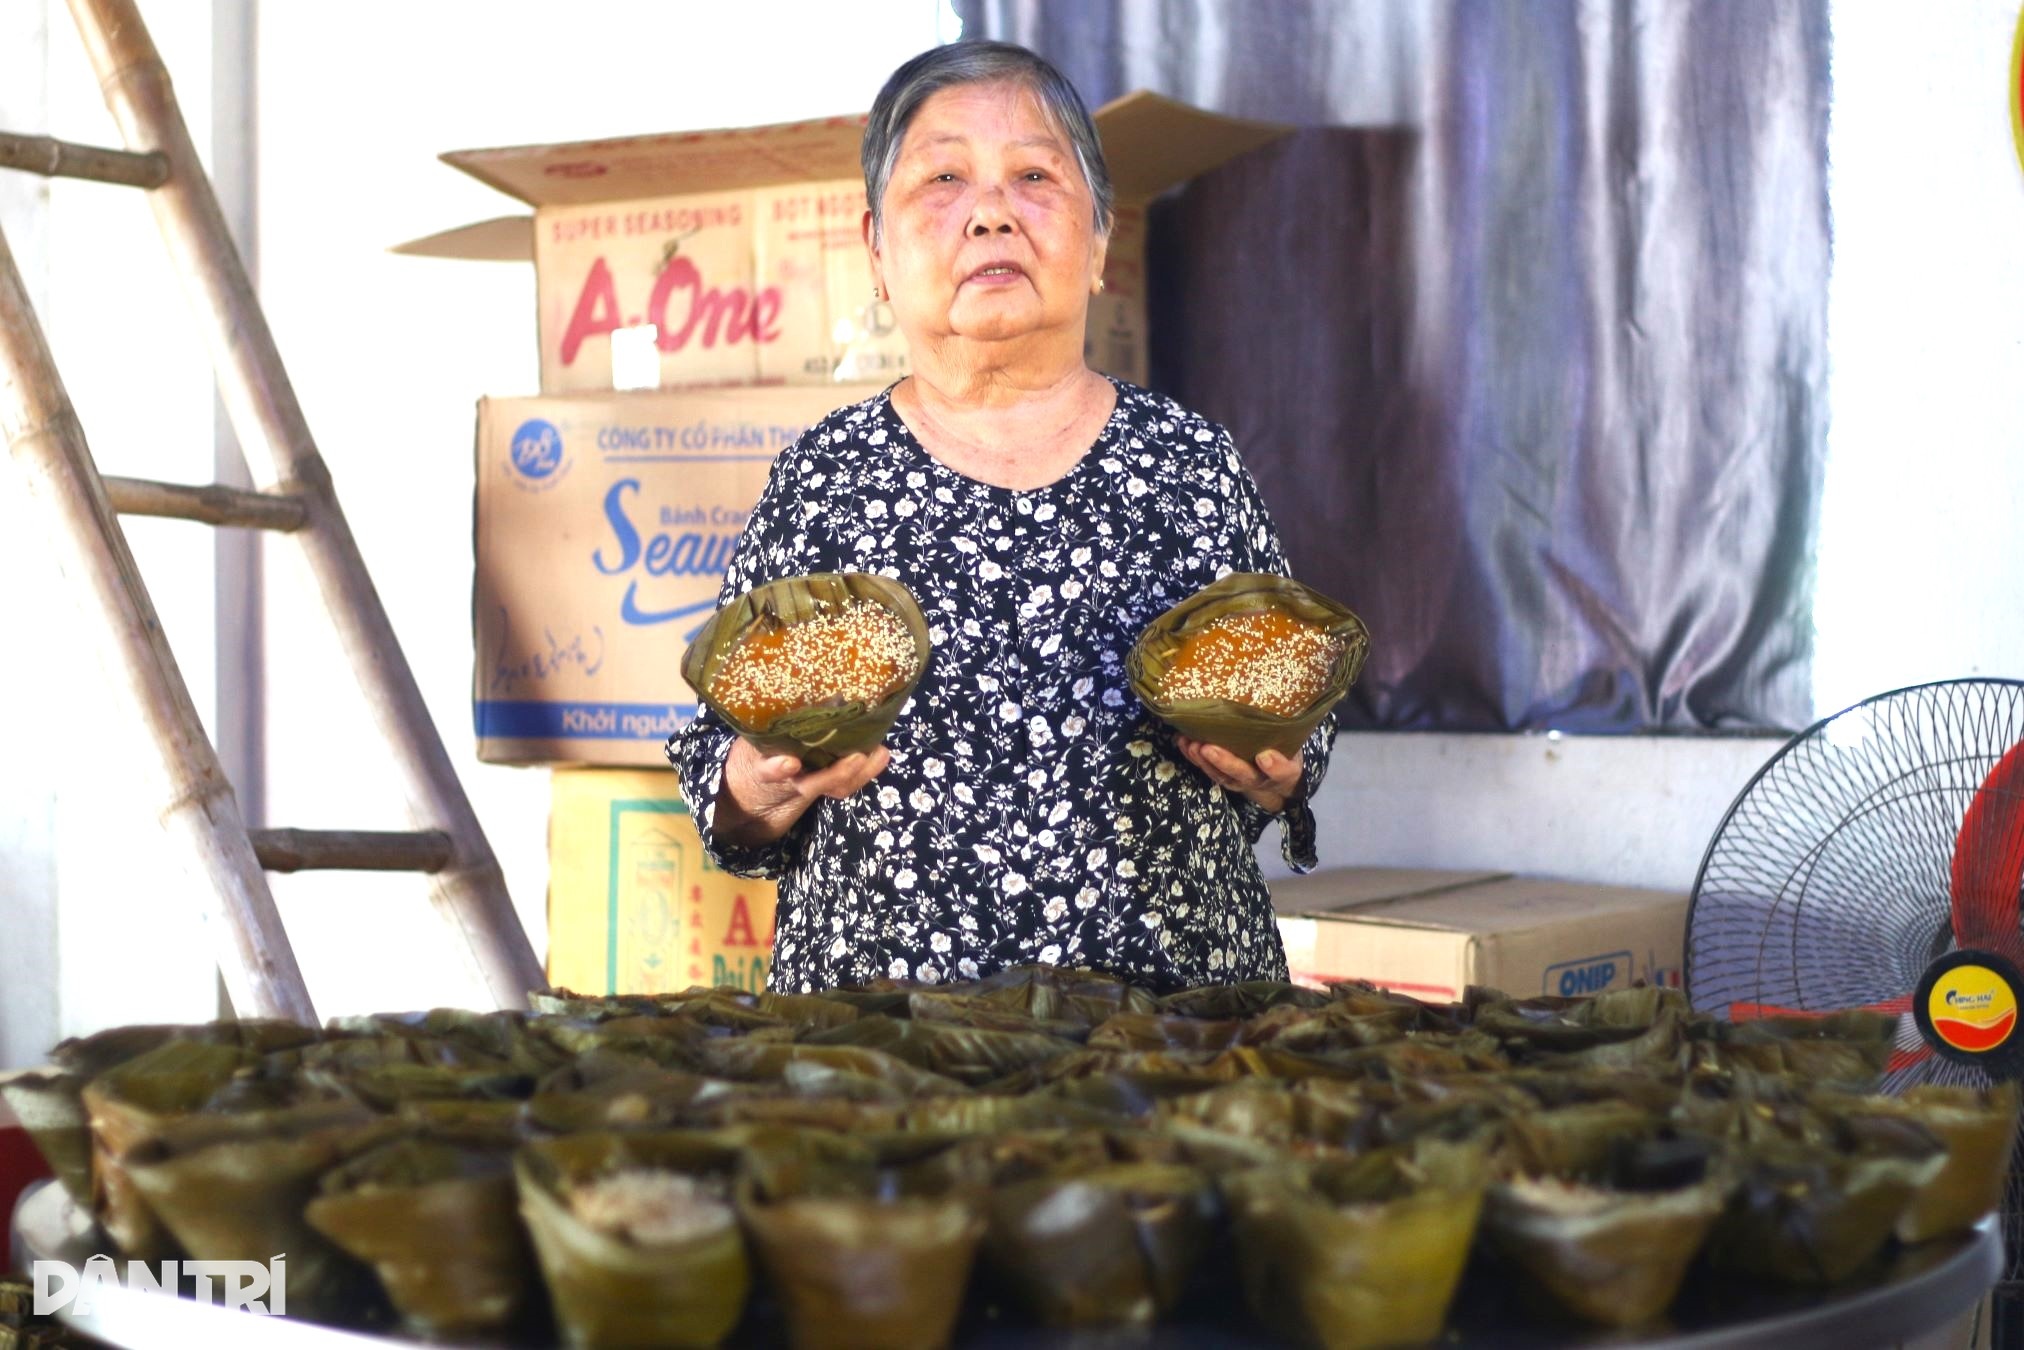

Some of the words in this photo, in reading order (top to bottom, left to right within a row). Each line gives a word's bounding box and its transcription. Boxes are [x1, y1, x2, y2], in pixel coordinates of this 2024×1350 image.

[553, 214, 617, 243] SUPER
[624, 203, 743, 235] SEASONING
[559, 254, 785, 368] A-One
